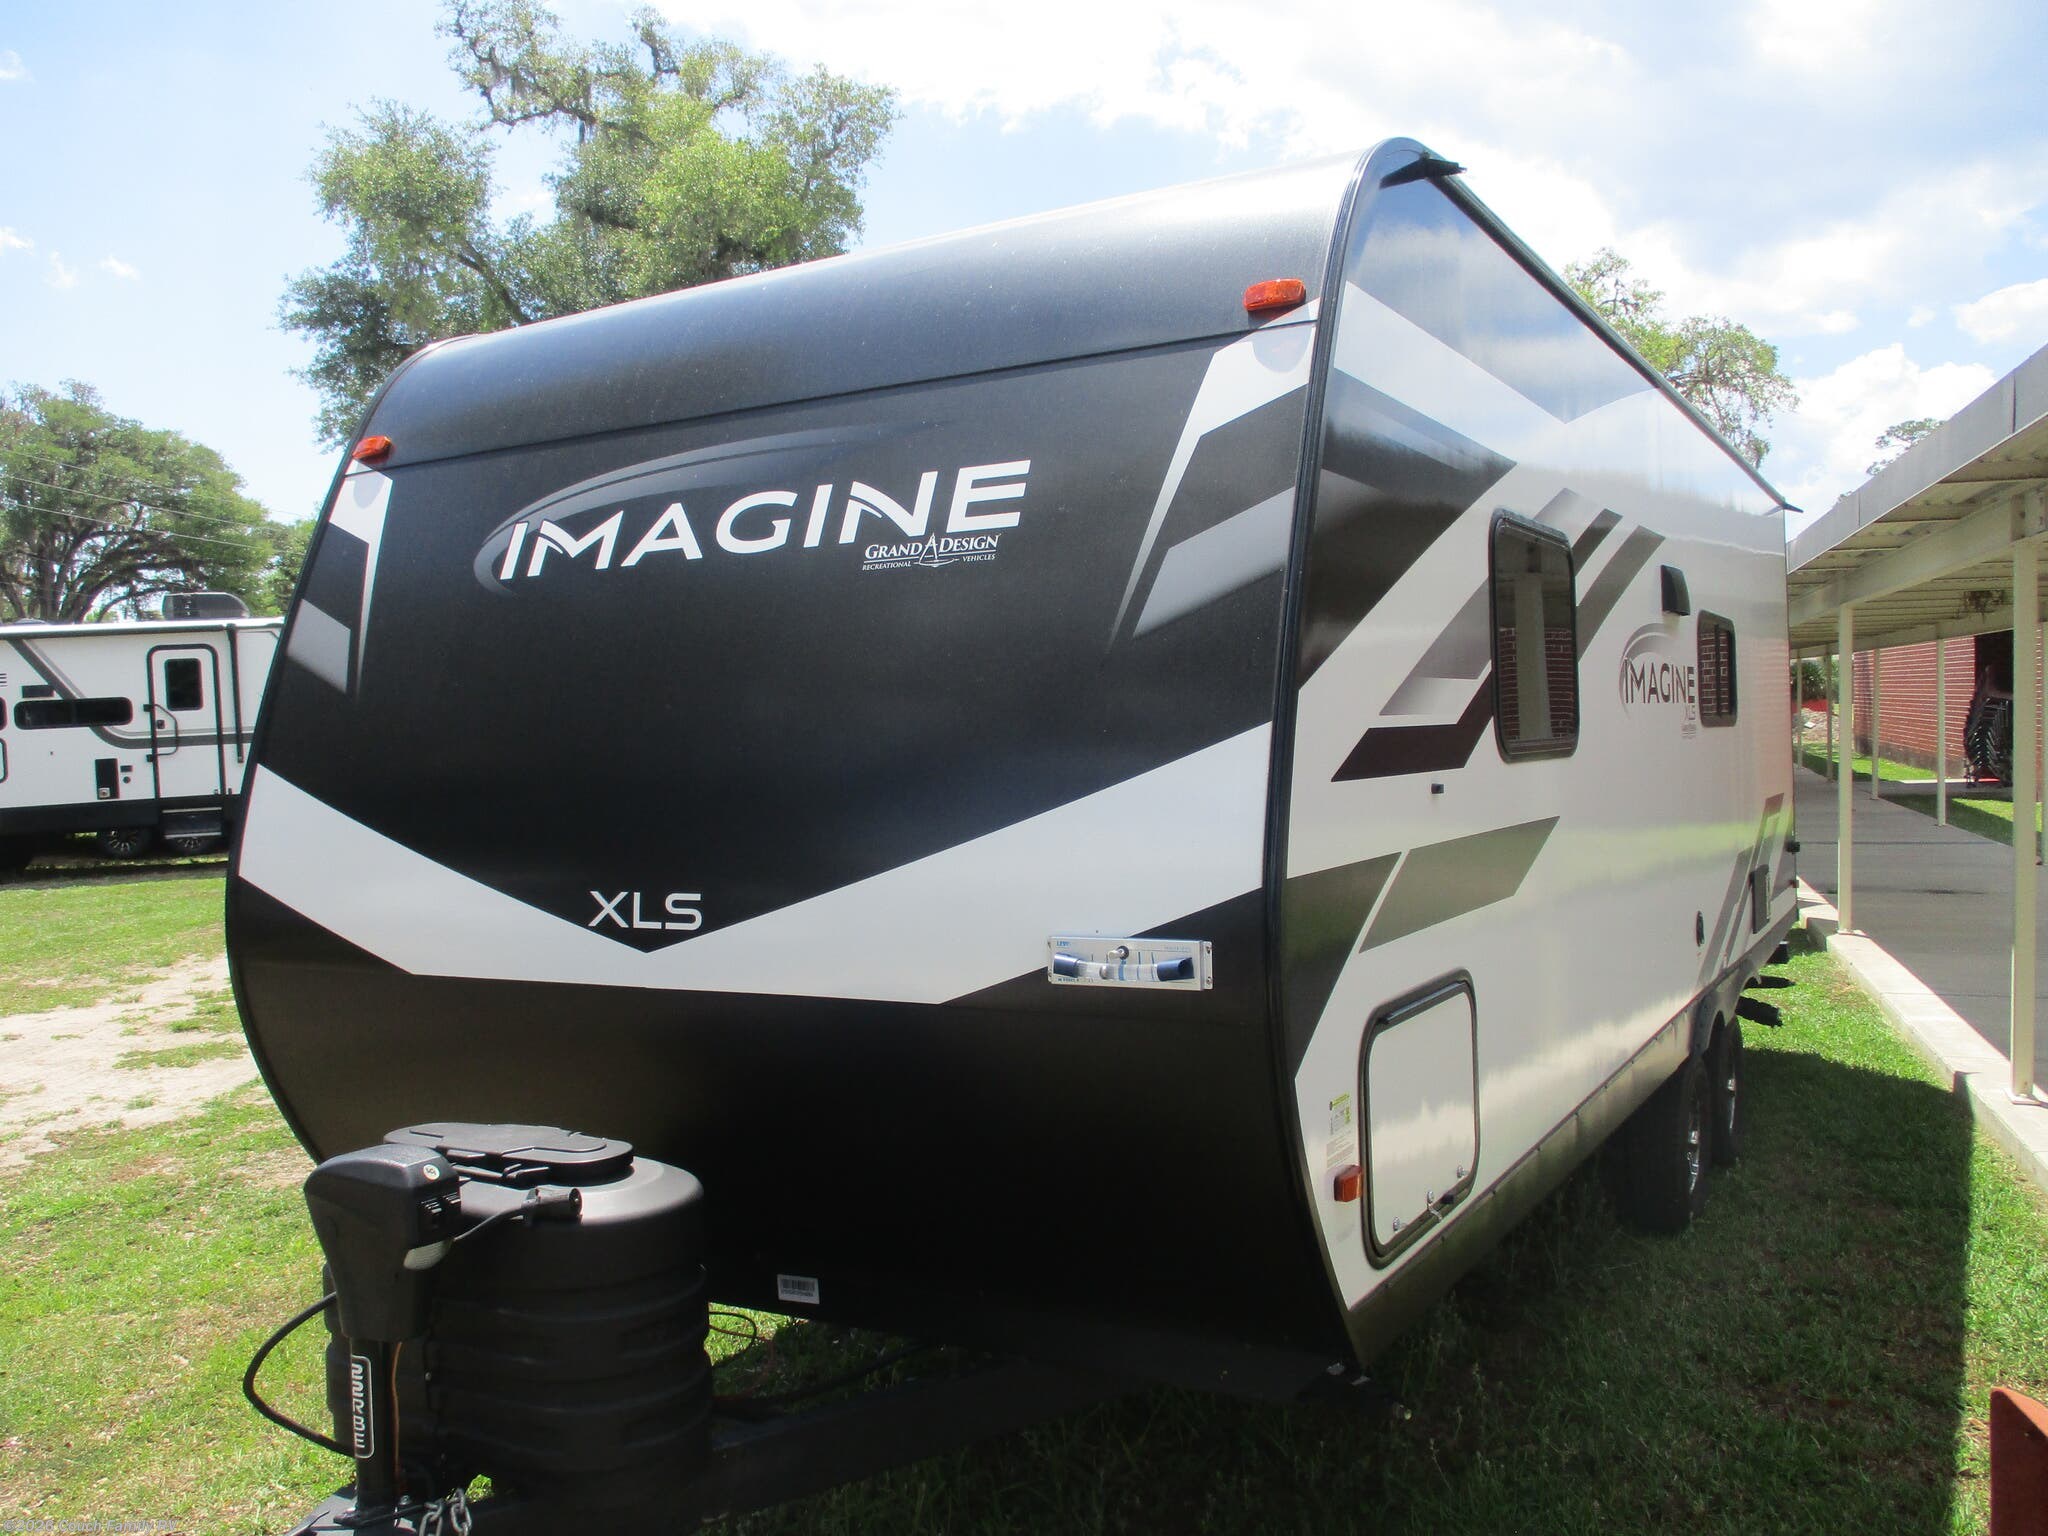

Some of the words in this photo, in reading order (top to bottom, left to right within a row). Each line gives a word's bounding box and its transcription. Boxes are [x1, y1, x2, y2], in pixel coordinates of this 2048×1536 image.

[500, 460, 1031, 580] IMAGINE
[862, 561, 912, 571] RECREATIONAL
[963, 553, 996, 562] VEHICLES
[865, 543, 922, 559] GRAND
[938, 535, 1001, 553] DESIGN
[1623, 659, 1696, 704] IMAGINE
[588, 891, 702, 930] XLS
